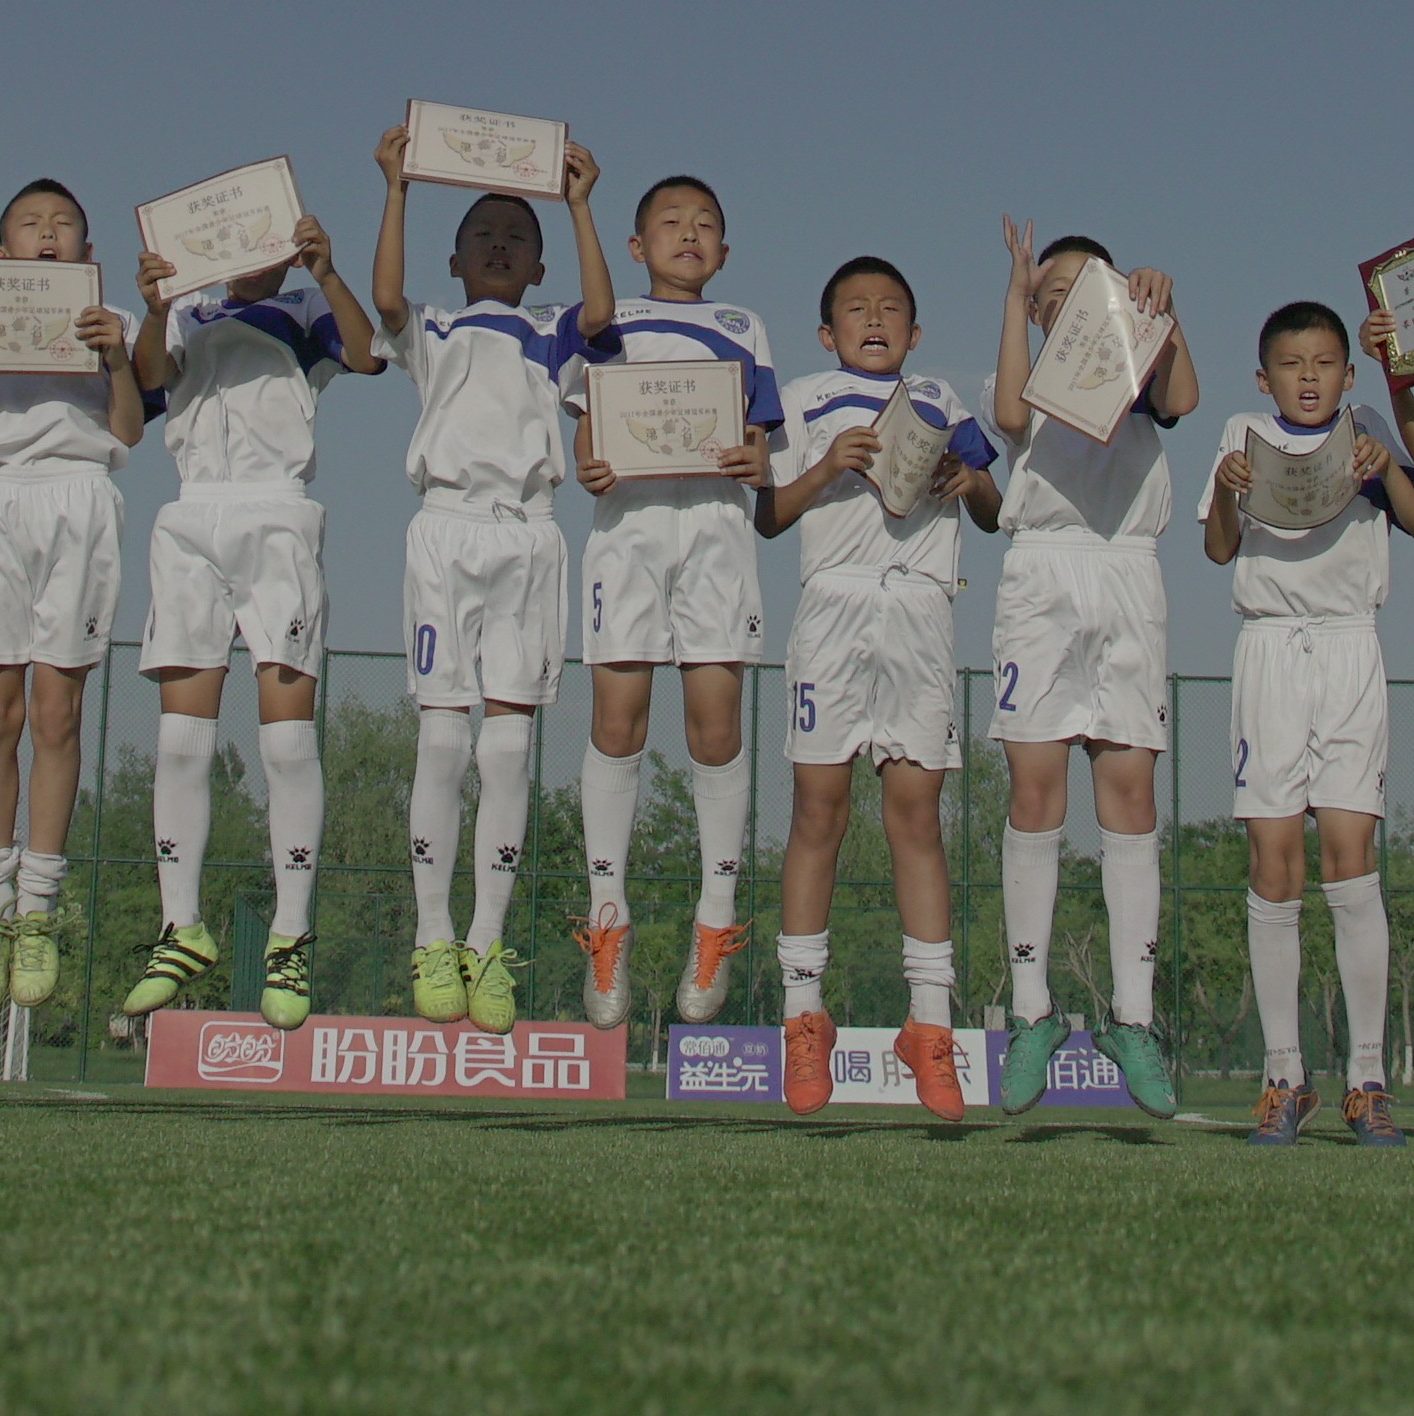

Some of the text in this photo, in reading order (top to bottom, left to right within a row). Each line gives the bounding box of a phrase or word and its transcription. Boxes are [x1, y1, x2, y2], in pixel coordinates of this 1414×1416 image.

[638, 380, 696, 395] 获奖证书
[311, 1027, 590, 1090] 盼盼食品
[679, 1058, 769, 1091] 益生元
